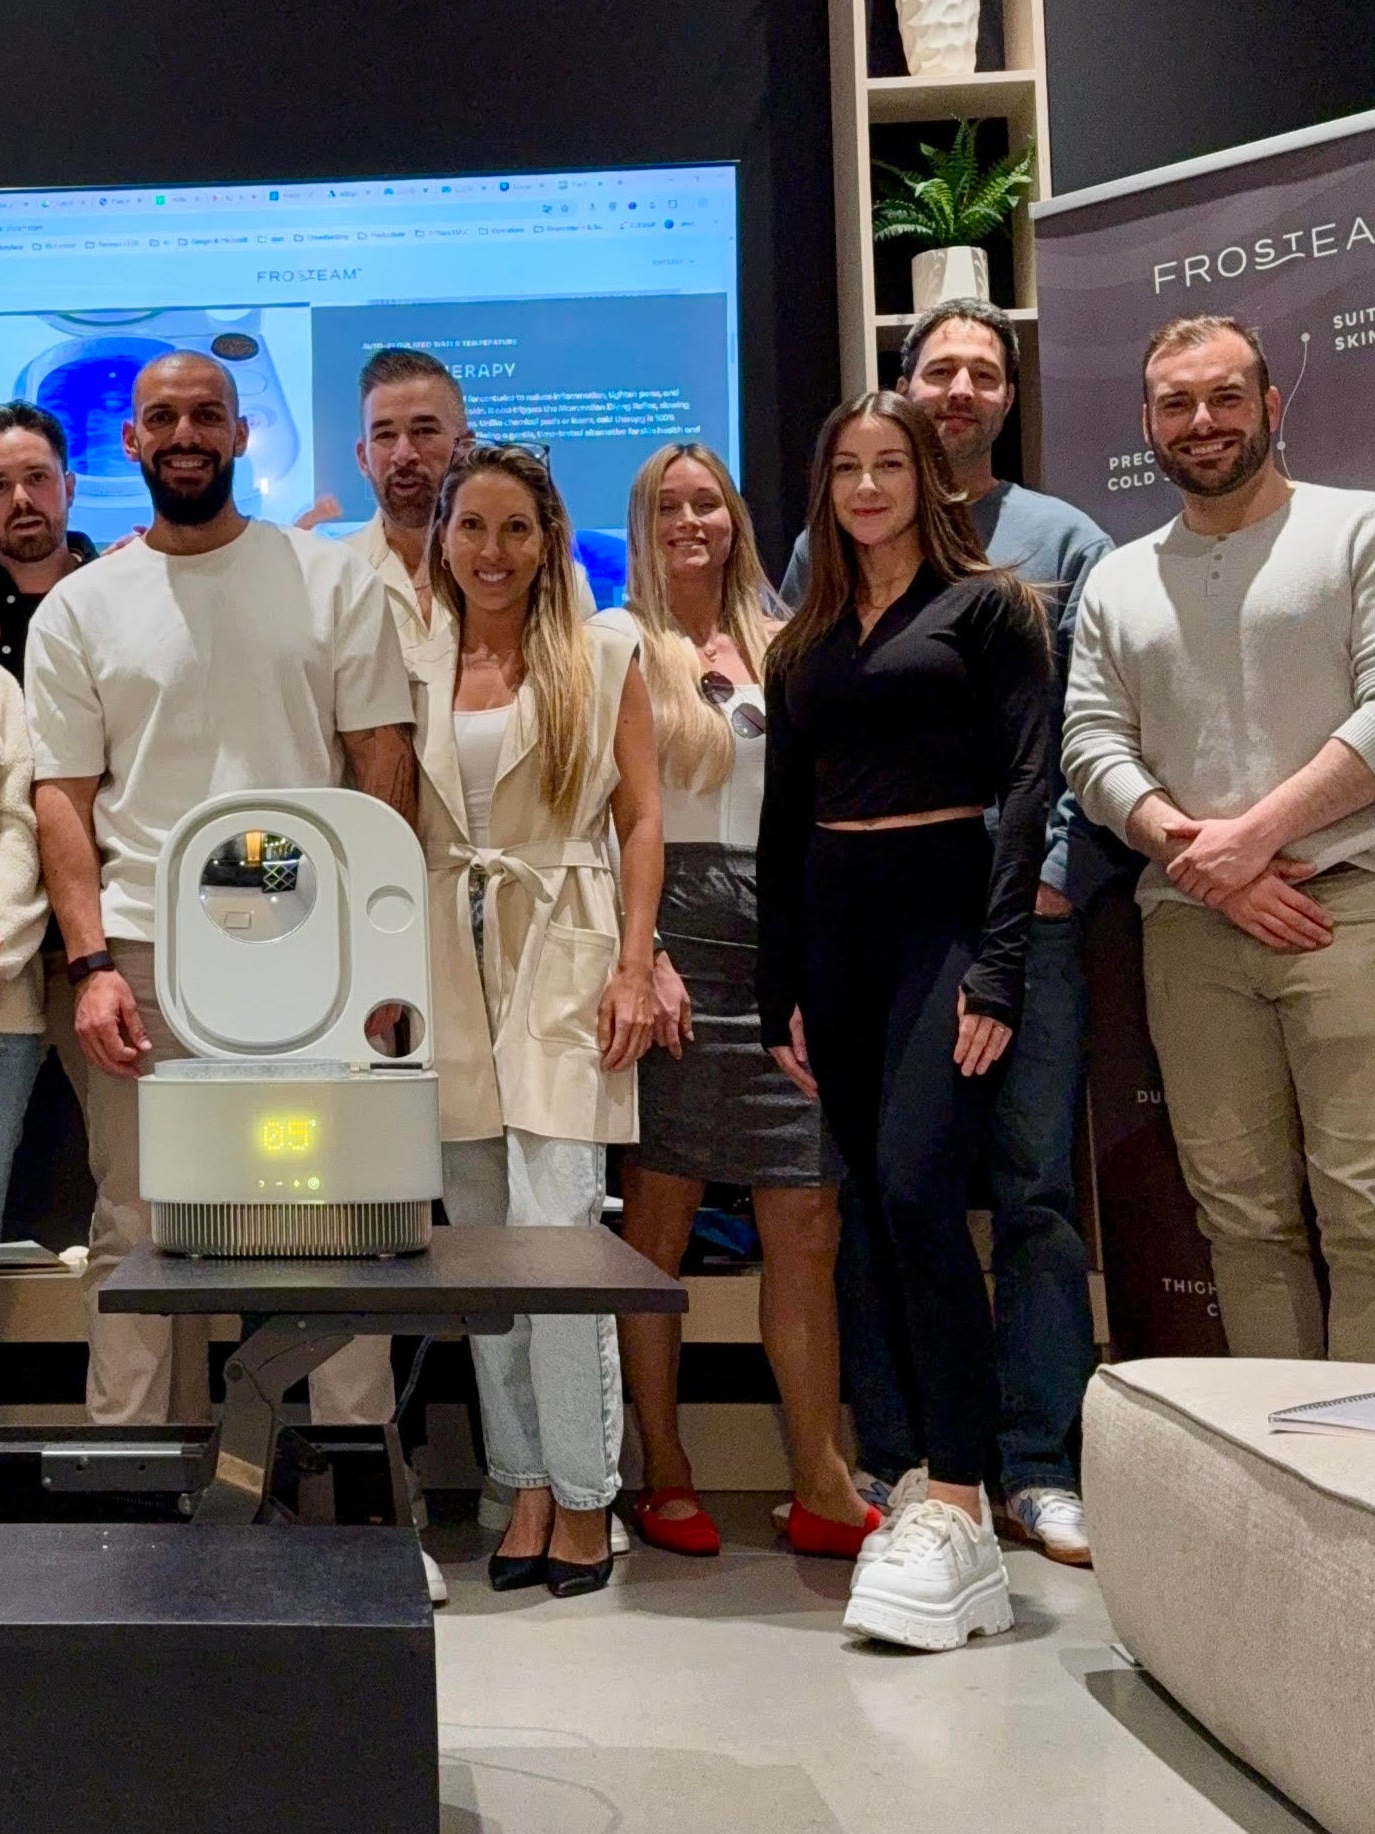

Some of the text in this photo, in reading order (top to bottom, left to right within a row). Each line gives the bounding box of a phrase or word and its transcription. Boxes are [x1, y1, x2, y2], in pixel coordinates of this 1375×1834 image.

[1154, 216, 1375, 295] FROSTEA
[1333, 307, 1375, 329] SUIT
[444, 362, 516, 379] ERAPY
[1109, 450, 1156, 470] PREC
[1107, 471, 1155, 492] COLD
[1137, 1090, 1162, 1104] DU
